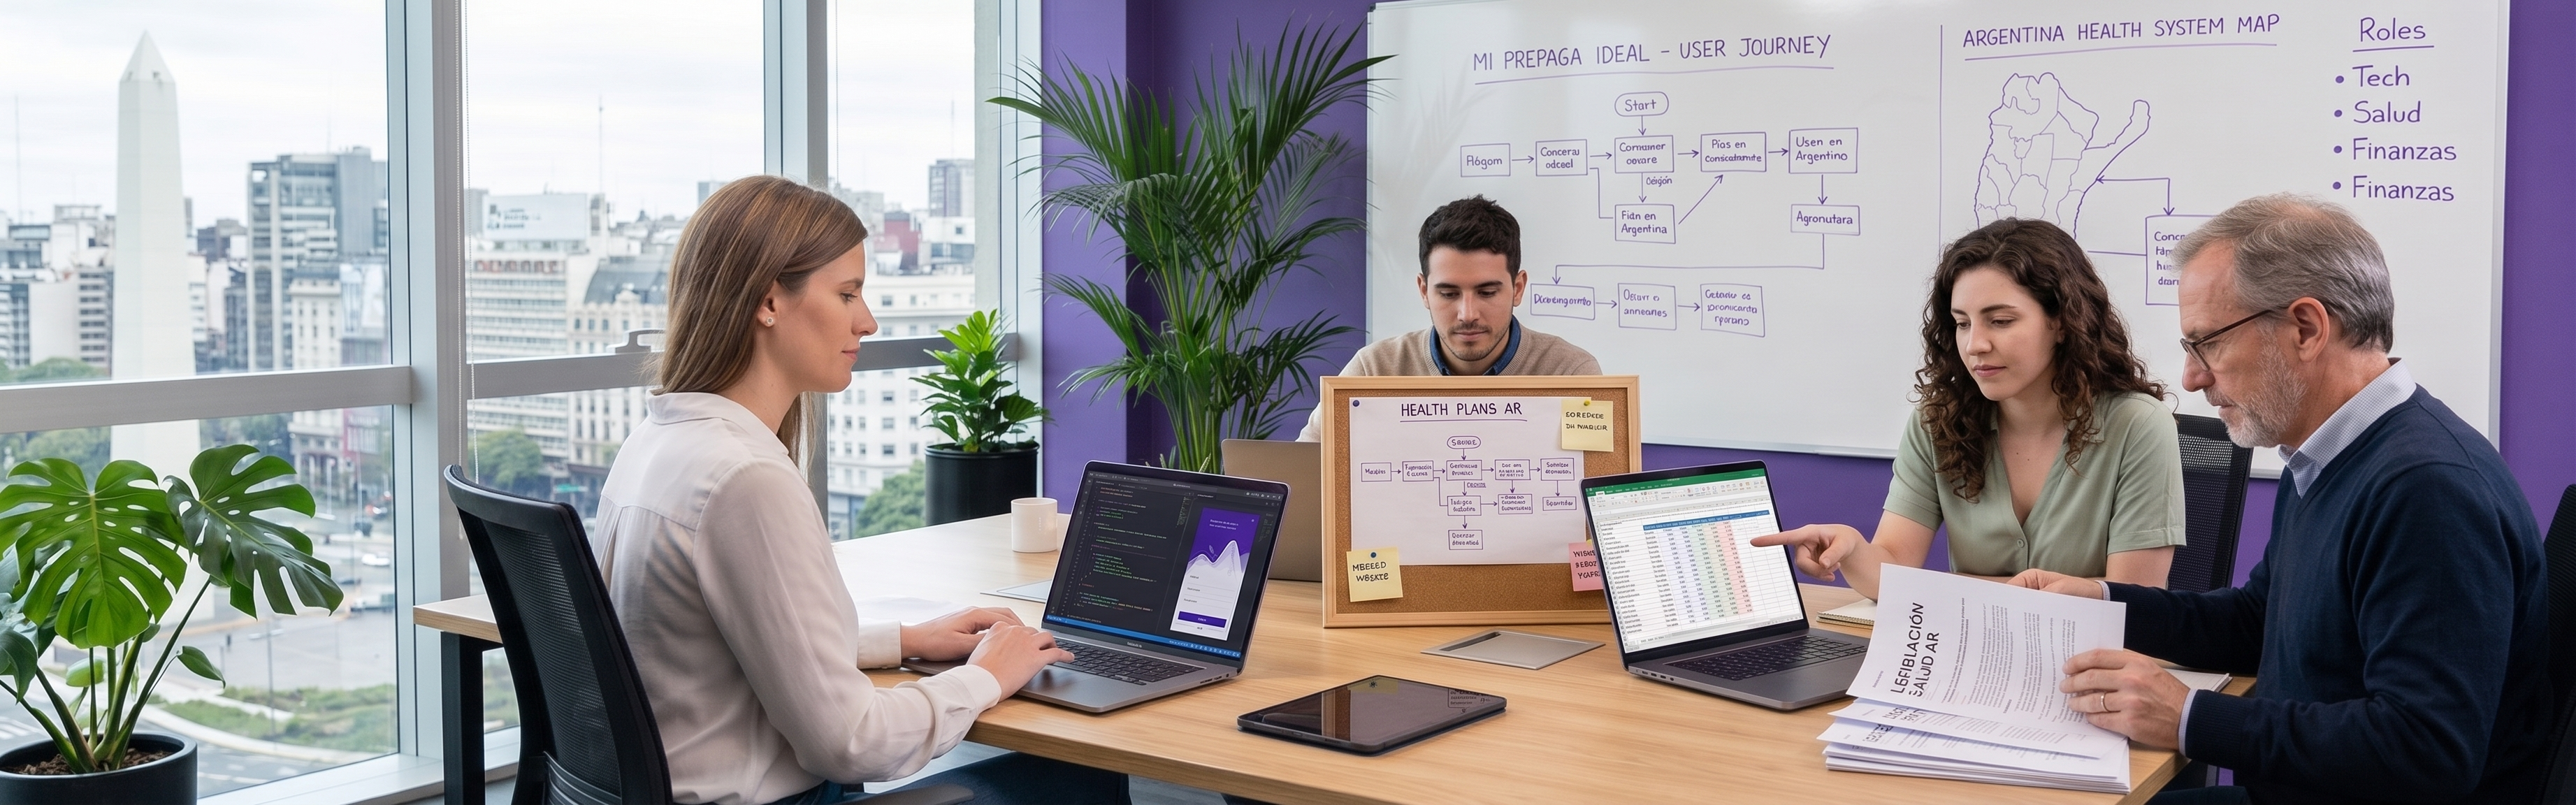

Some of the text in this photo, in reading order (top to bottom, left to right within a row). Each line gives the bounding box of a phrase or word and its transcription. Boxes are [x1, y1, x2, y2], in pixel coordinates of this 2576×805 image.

[1962, 13, 2280, 48] ARGENTINA HEALTH SYSTEM MAP
[2360, 17, 2426, 42] Roles
[1473, 52, 1492, 71] MI
[1504, 48, 1582, 69] PREPAGA
[1597, 44, 1650, 64] IDEAL
[1680, 39, 1726, 59] USER
[1739, 34, 1831, 59] JOURNEY
[2352, 64, 2410, 87] Tech
[1625, 99, 1657, 112] Start
[2353, 100, 2421, 124] Salud
[1795, 136, 1823, 147] Usen
[2353, 137, 2457, 161] Finanzas
[2353, 175, 2454, 201] Finanzas
[1621, 223, 1667, 238] Argentina
[1401, 402, 1523, 416] HEALTH PLANS AR
[1925, 632, 1940, 653] AR
